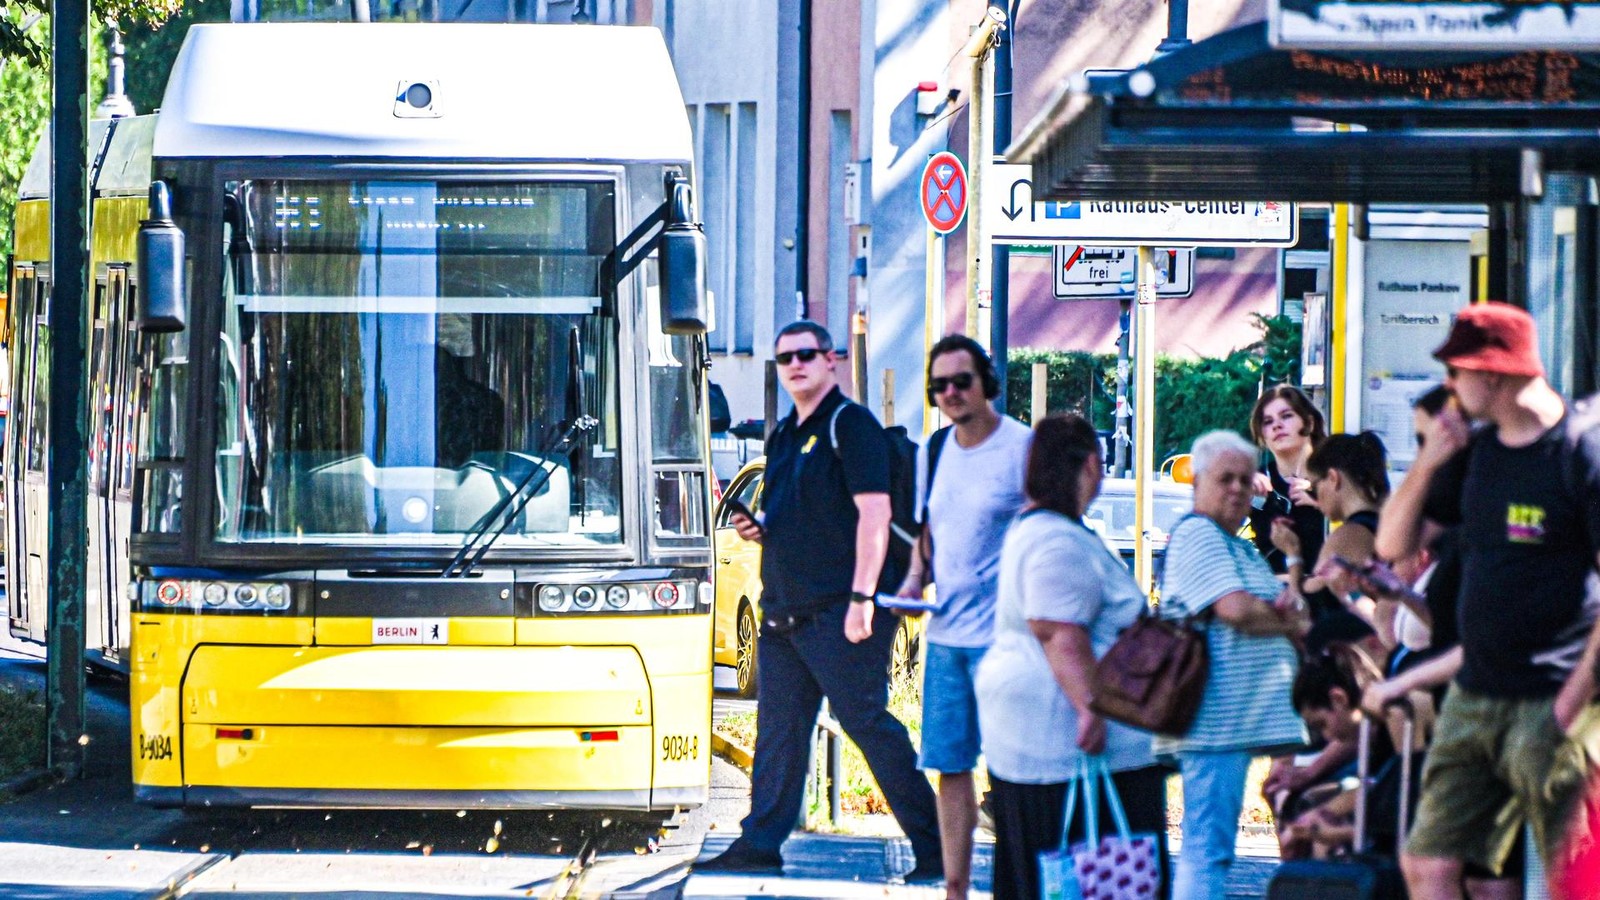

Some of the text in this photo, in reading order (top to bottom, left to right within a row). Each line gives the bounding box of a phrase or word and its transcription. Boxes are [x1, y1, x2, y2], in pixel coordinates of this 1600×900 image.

[1089, 267, 1109, 279] frei
[1378, 281, 1460, 292] Rathaus Pankow
[1380, 314, 1439, 325] Tarifbereich
[377, 627, 417, 637] BERLIN
[662, 735, 698, 761] 9034-B
